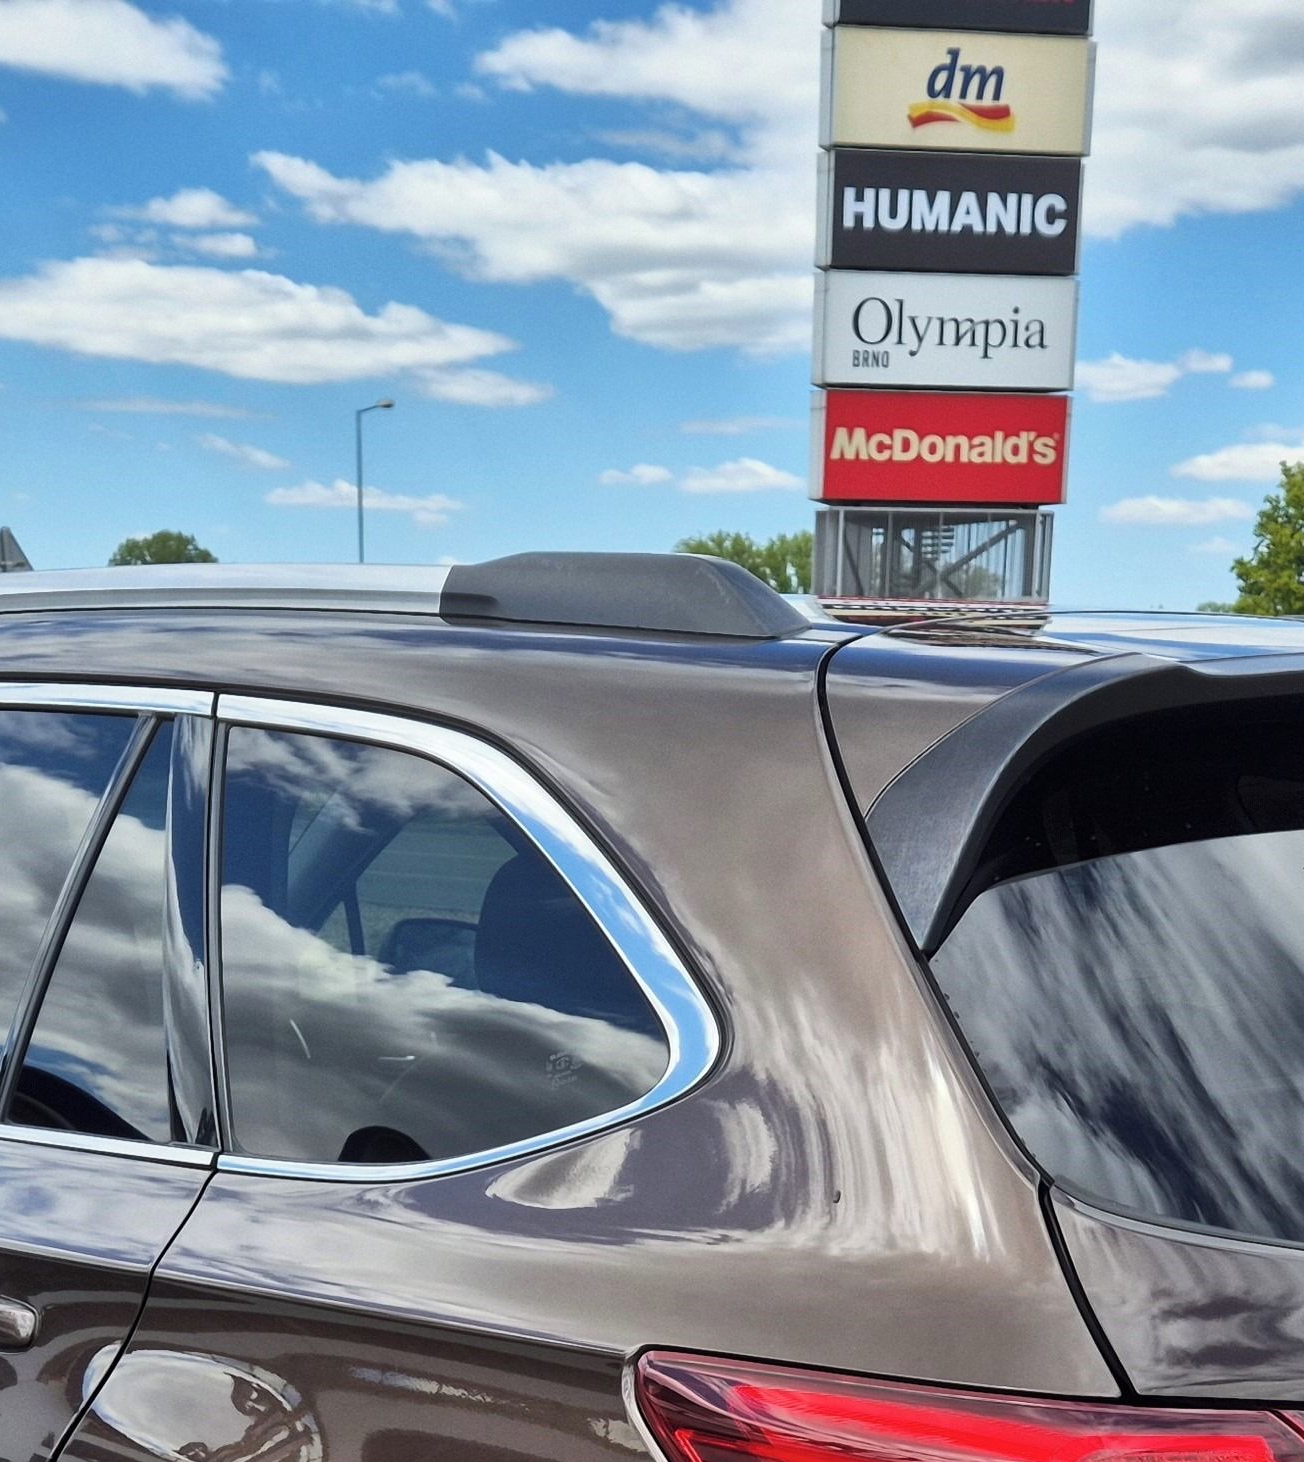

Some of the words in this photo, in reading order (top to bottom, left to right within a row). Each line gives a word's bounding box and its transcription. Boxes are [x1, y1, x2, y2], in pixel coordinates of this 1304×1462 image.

[925, 47, 1006, 102] dm
[841, 186, 1069, 238] HUMANIC
[851, 296, 1049, 360] Olympia
[851, 349, 891, 370] BRNO
[829, 426, 1059, 466] McDonald's
